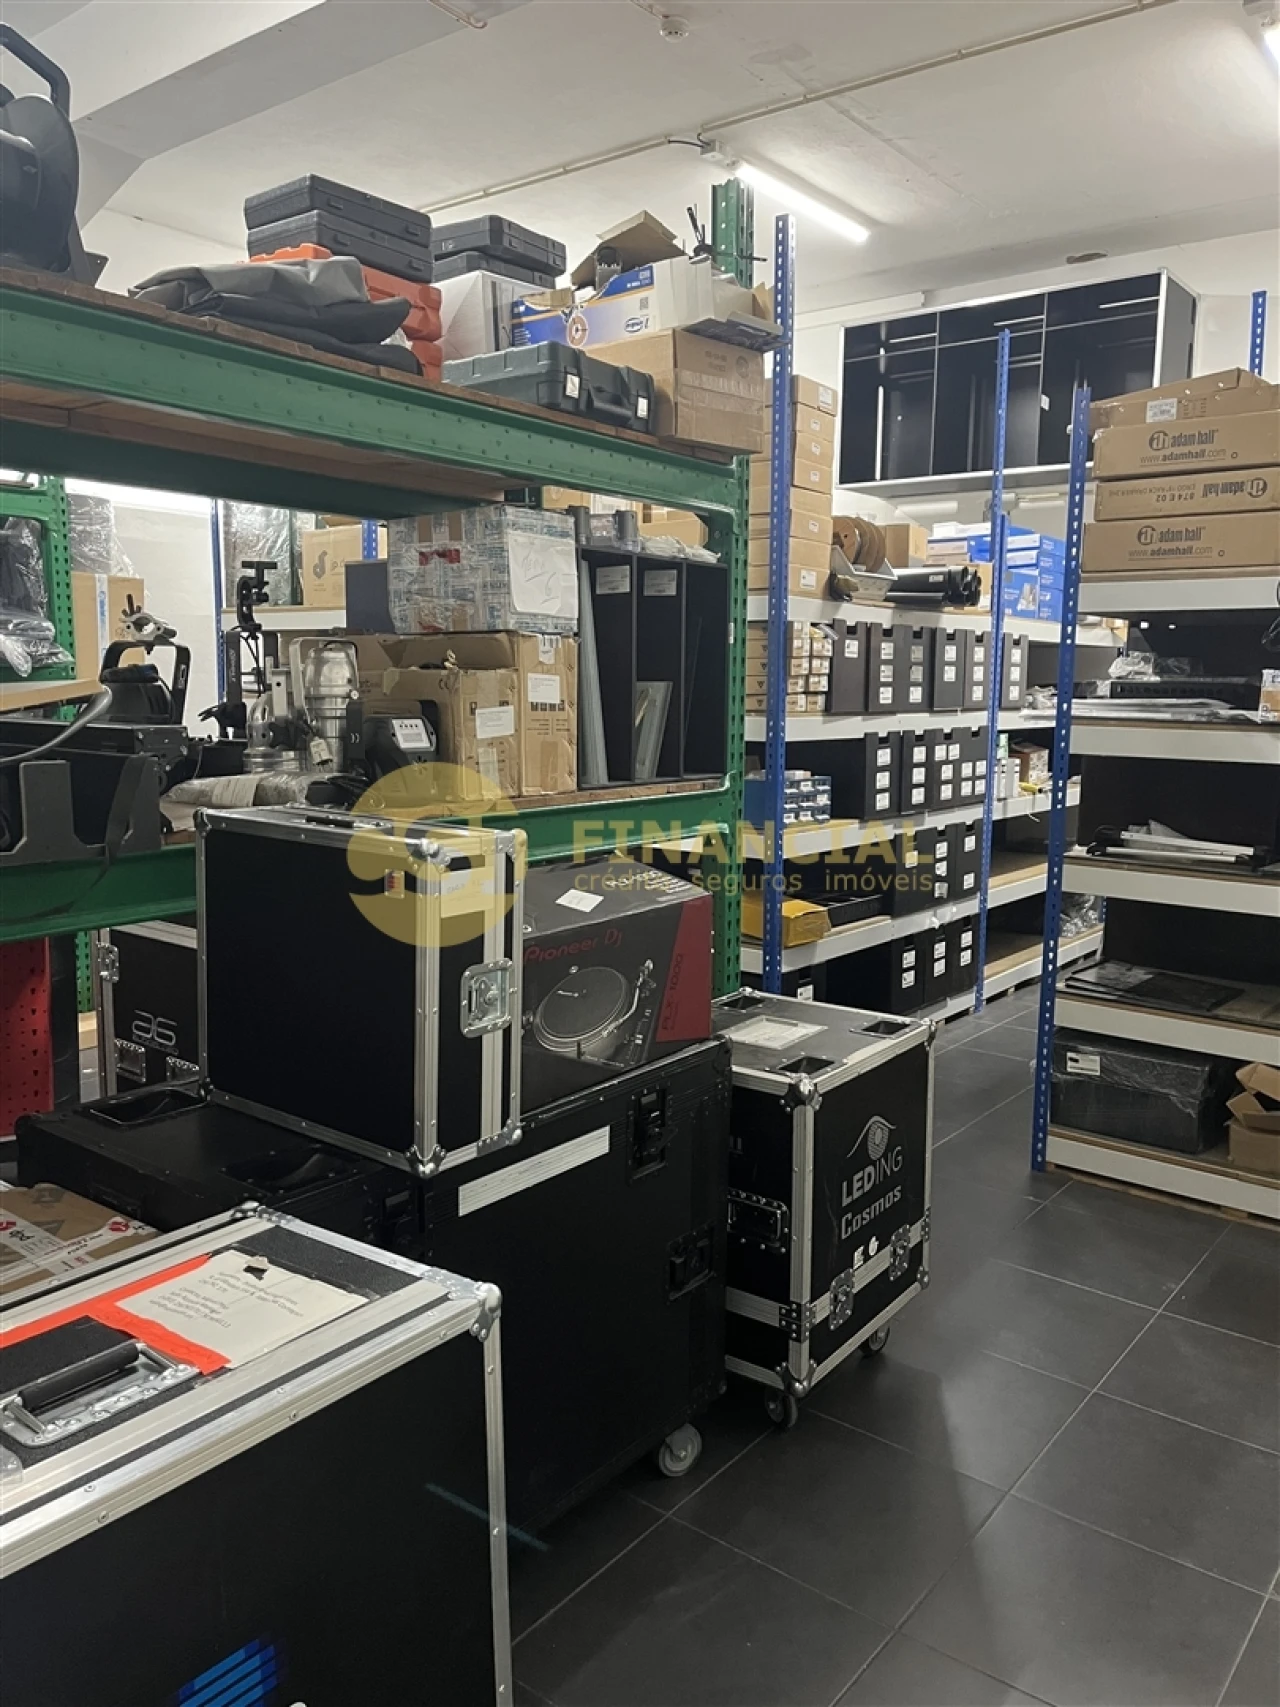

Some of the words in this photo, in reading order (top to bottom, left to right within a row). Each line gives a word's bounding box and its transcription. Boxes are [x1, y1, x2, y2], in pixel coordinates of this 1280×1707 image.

[1170, 431, 1196, 447] adam
[1139, 449, 1227, 463] www.adamhall.com
[1158, 527, 1184, 543] adam
[1127, 545, 1213, 558] www.adamhall.com
[524, 937, 599, 965] Pioneer
[841, 1145, 903, 1207] LEDING
[841, 1184, 902, 1240] Cosmos
